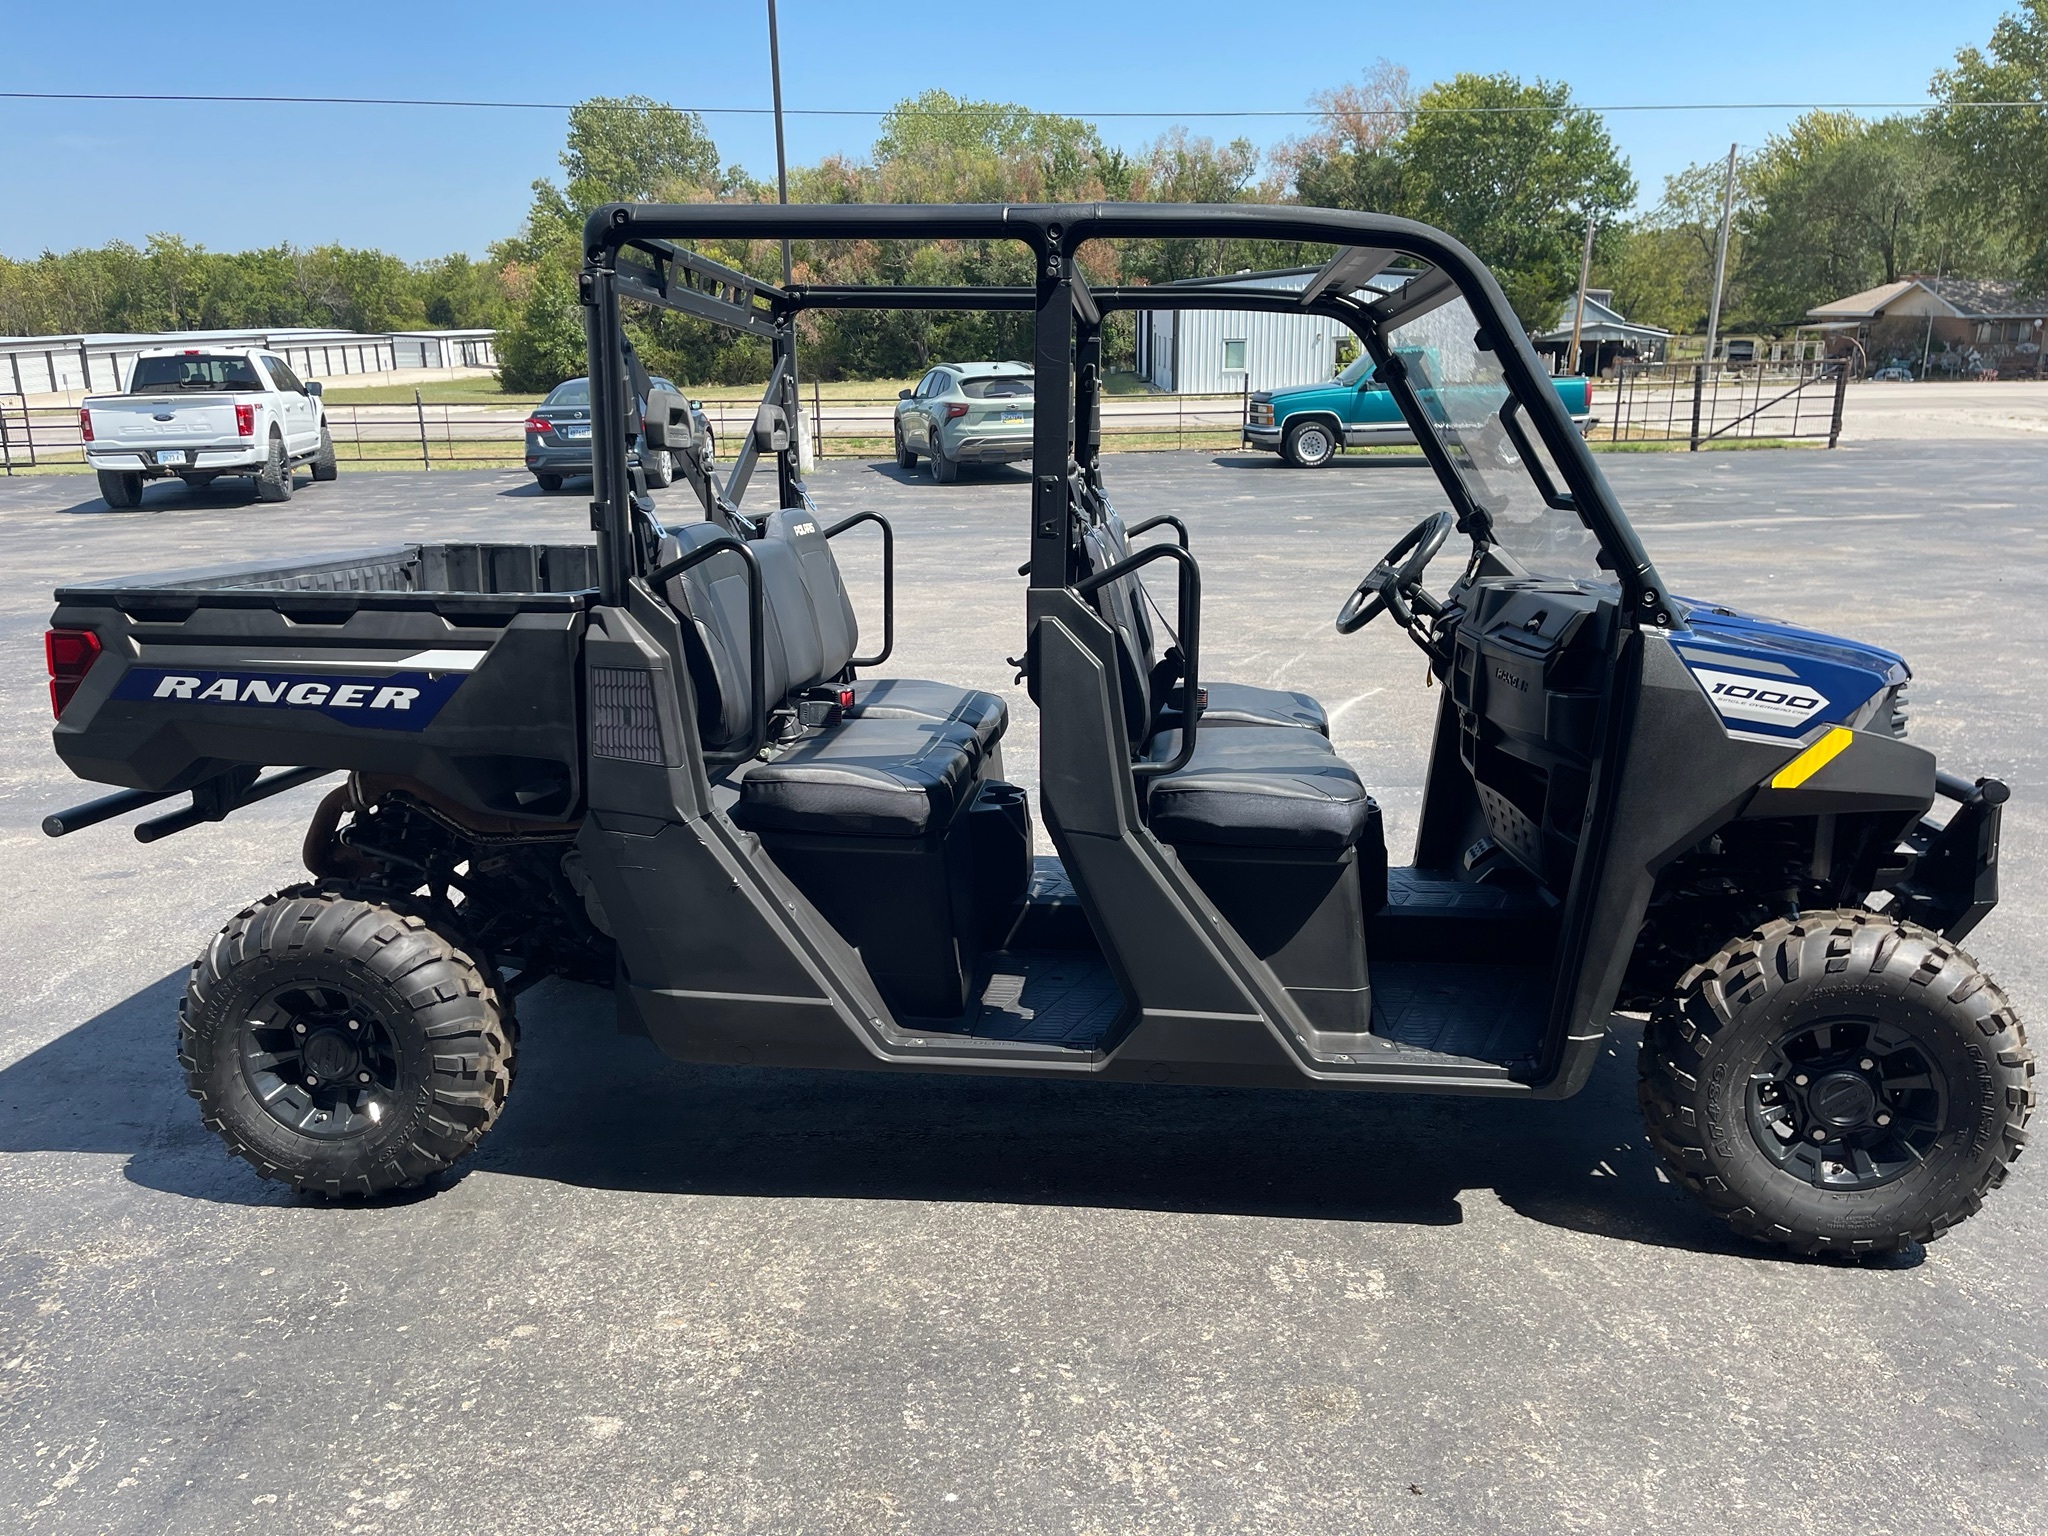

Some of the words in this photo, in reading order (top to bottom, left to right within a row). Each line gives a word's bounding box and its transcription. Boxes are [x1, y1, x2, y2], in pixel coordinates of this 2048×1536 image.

[118, 423, 213, 436] F-150
[793, 522, 816, 537] POLARIS
[153, 675, 420, 710] RANGER
[1711, 682, 1819, 710] 1000
[1717, 697, 1747, 706] SINGLE
[1749, 702, 1792, 713] OVERHEAD
[1707, 1063, 1735, 1158] AT489
[1964, 1043, 1996, 1164] CARLISLE
